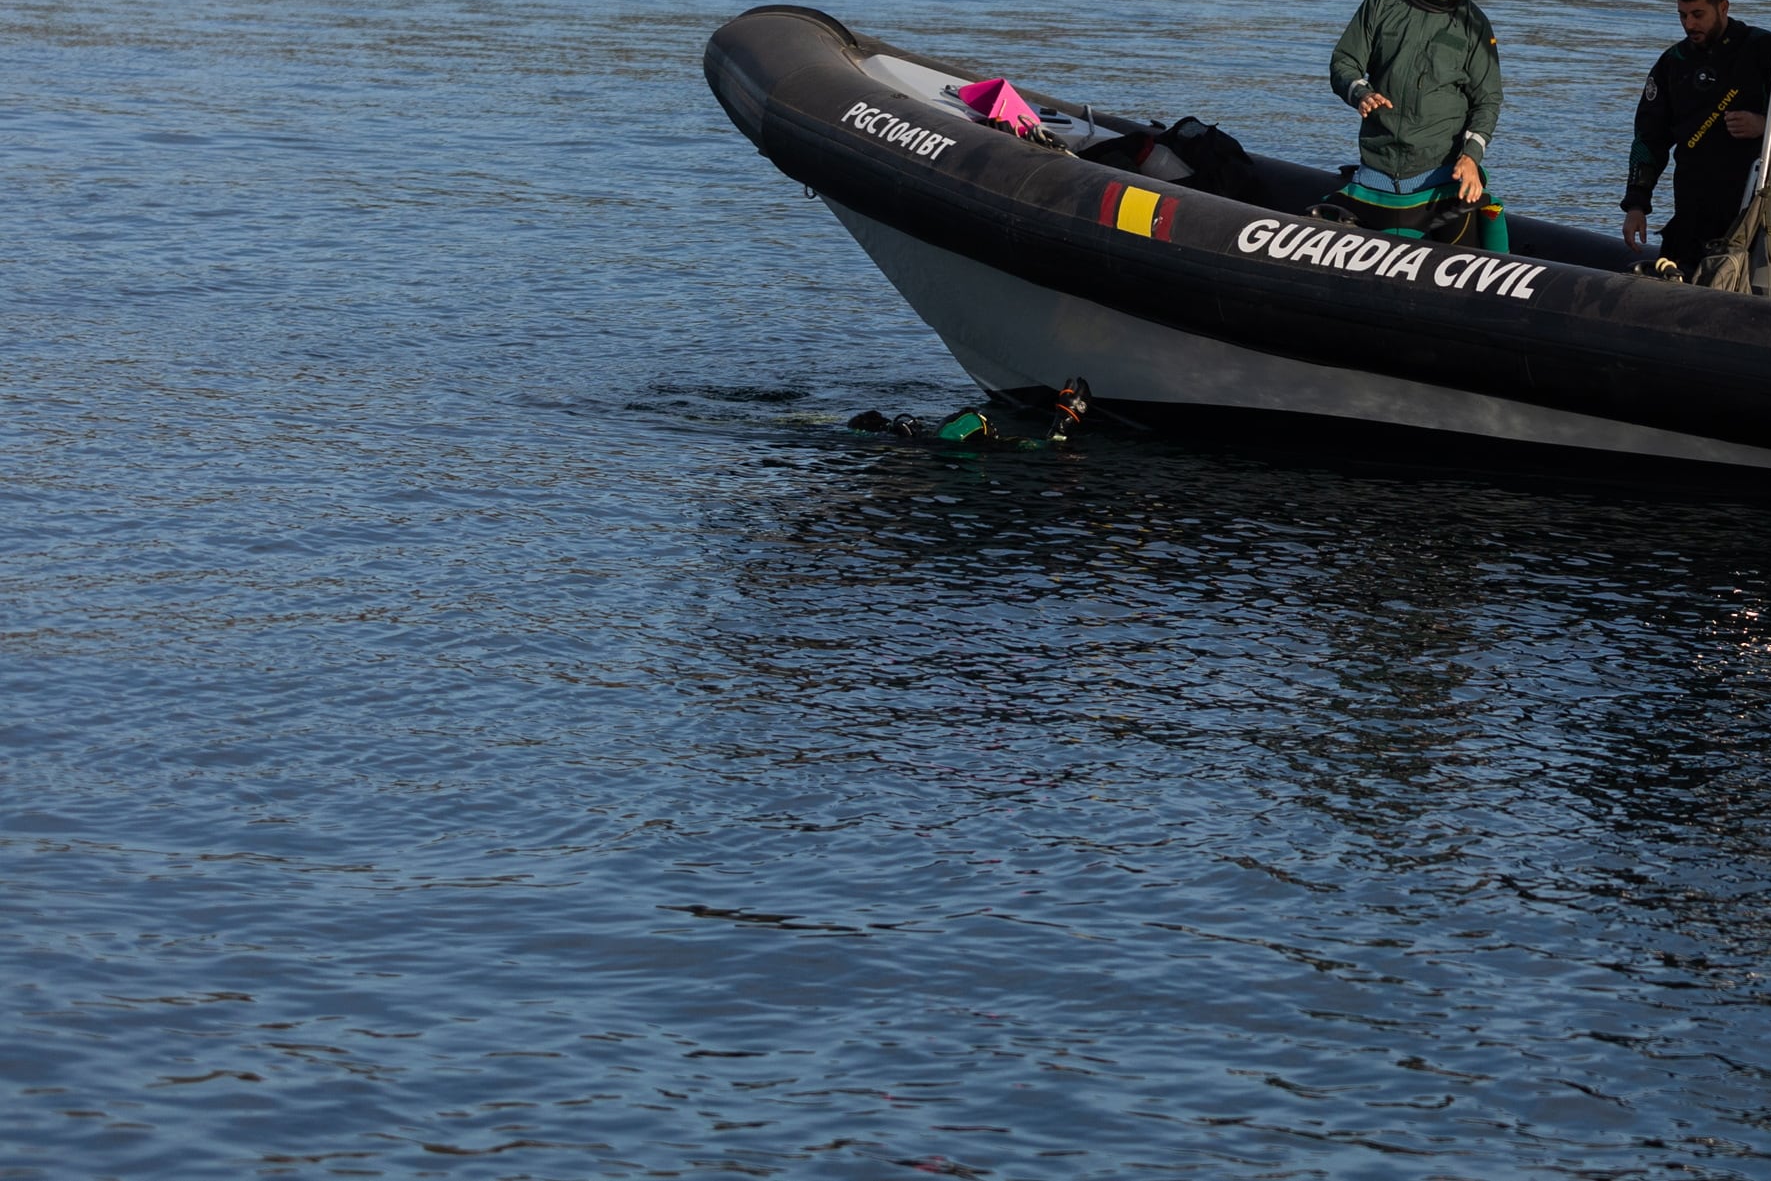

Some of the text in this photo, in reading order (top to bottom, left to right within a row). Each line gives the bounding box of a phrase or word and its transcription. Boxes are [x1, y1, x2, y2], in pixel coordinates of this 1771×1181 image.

[841, 101, 957, 160] PGC1041BT
[1688, 89, 1739, 148] GUARDIA CIVIL
[1238, 219, 1547, 299] GUARDIA CIVIL
